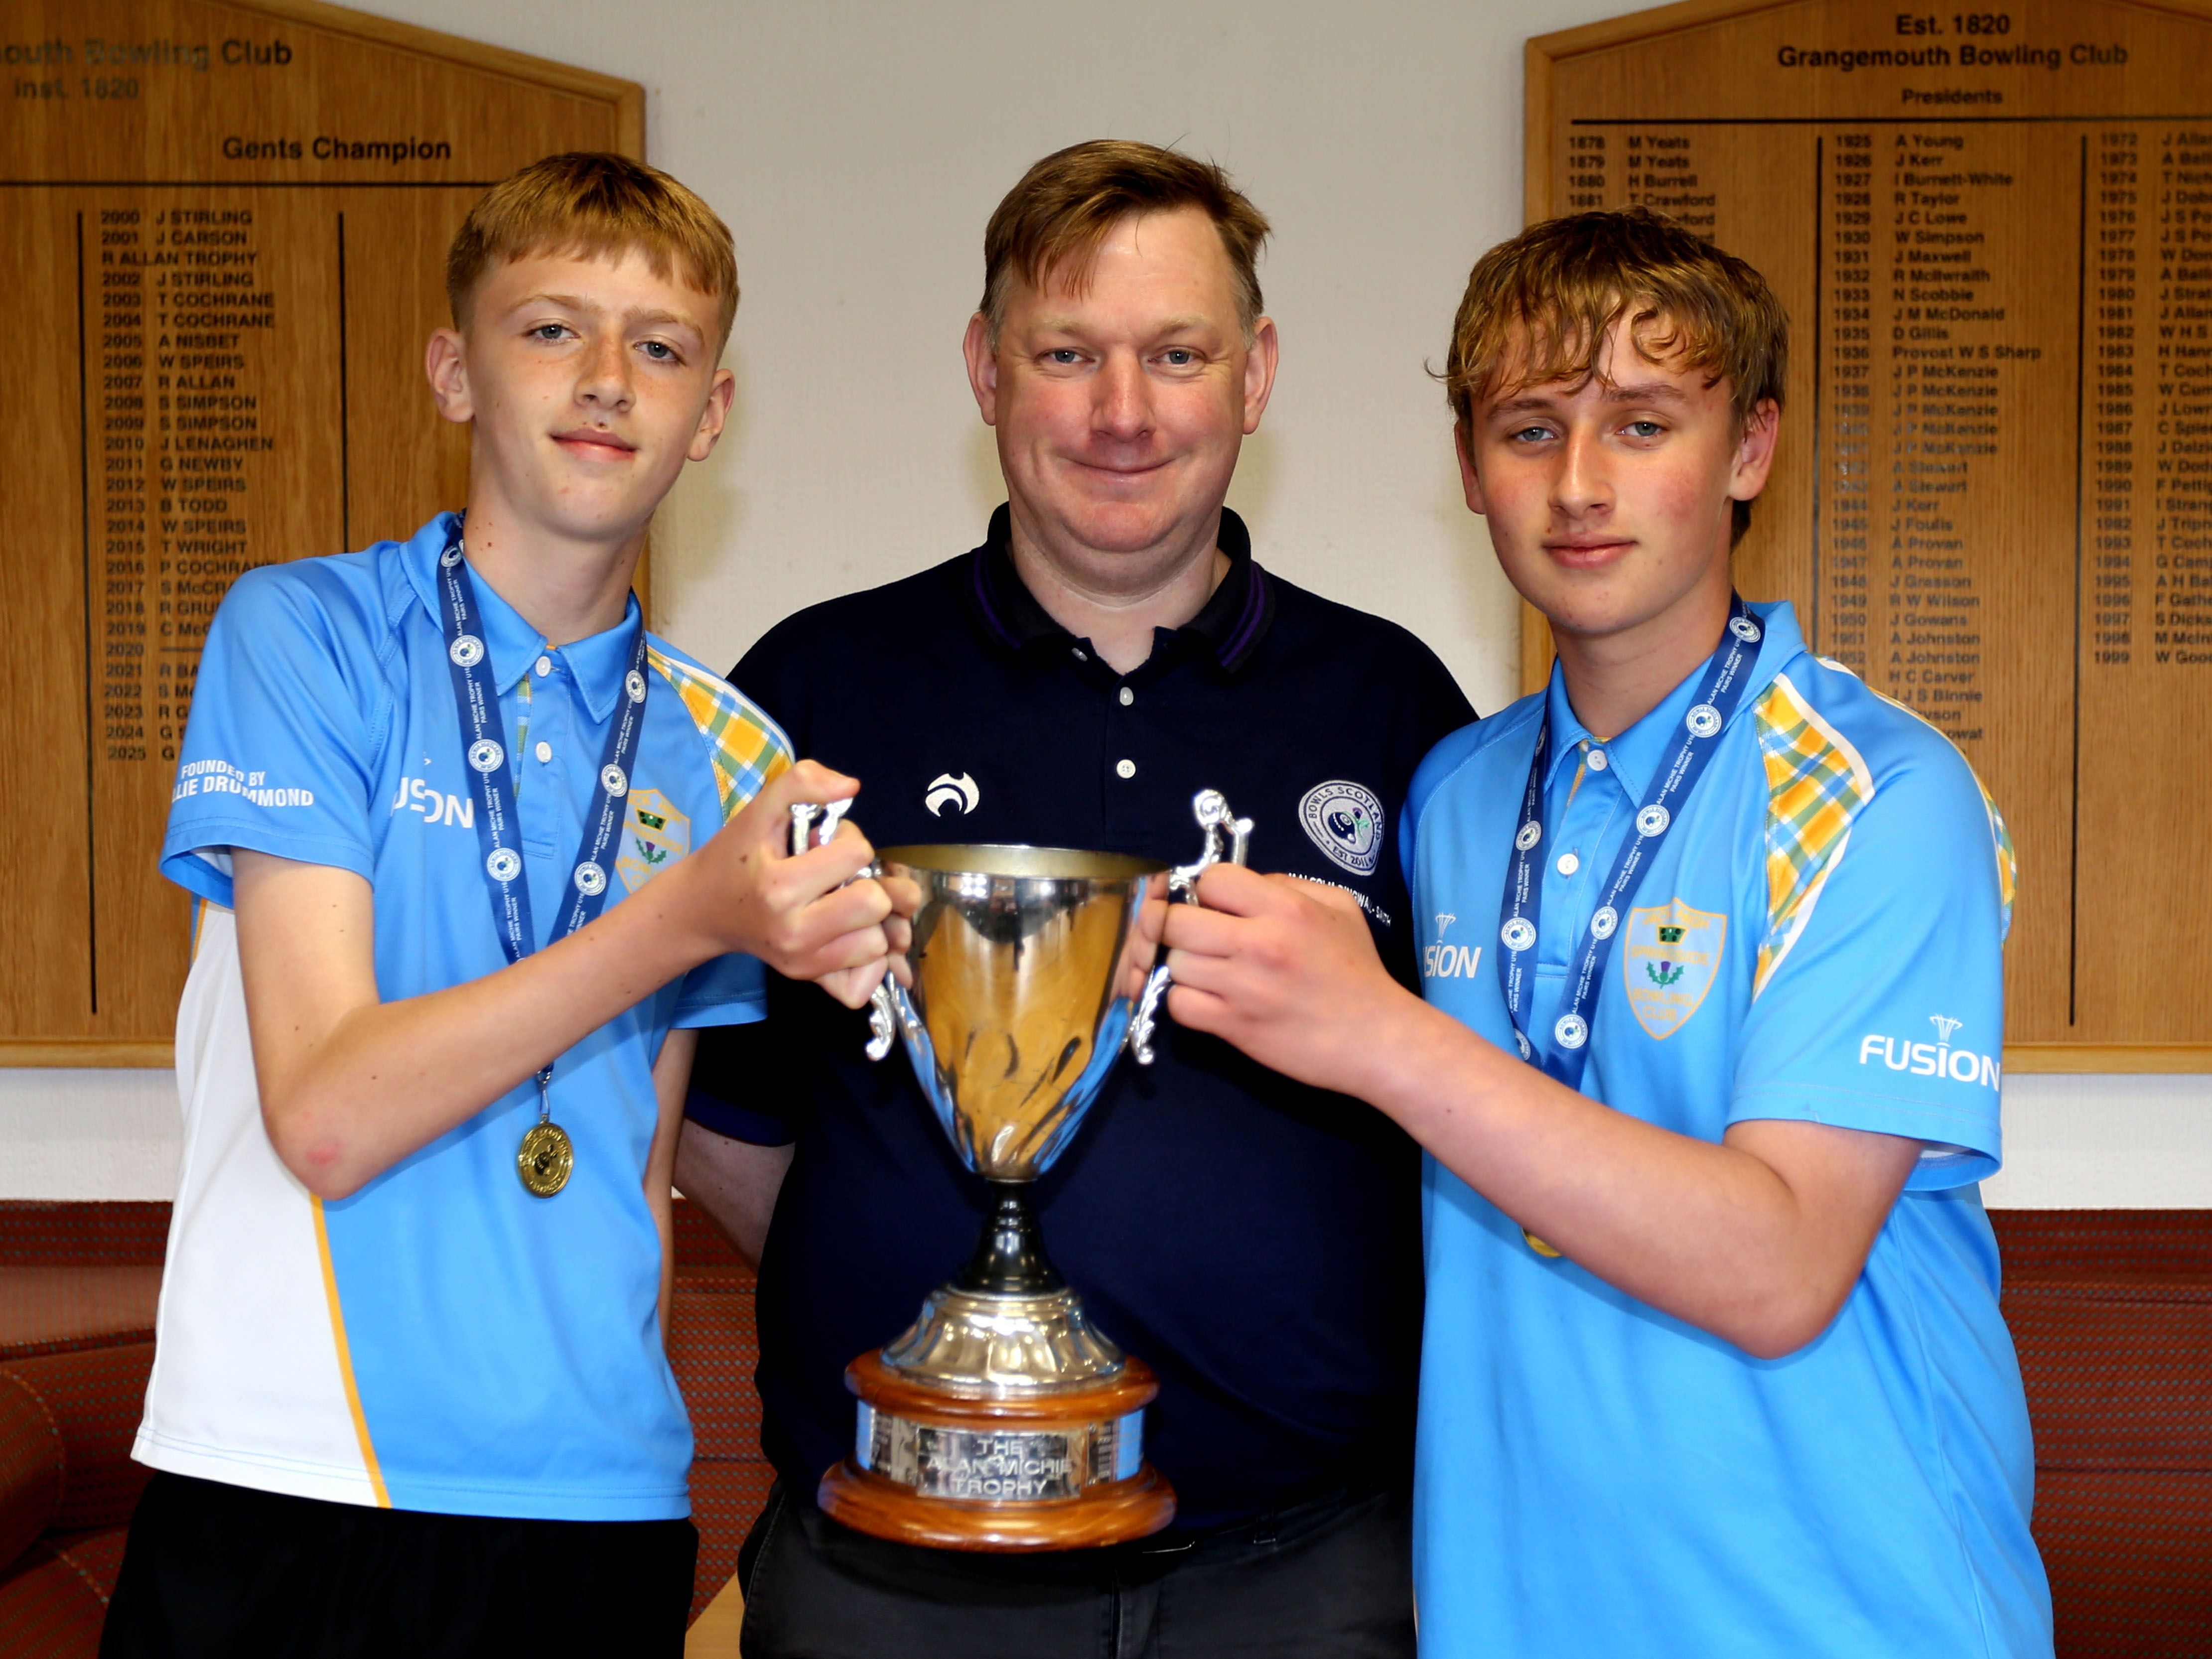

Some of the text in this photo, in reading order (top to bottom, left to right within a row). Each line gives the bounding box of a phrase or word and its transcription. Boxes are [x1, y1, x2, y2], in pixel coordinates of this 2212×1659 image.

[1897, 15, 2010, 35] Est. 1820
[4, 39, 292, 71] outh Bowling Club
[1778, 44, 2127, 71] Grangemouth Bowling Club
[1902, 89, 2003, 104] Presidents
[223, 136, 451, 165] Gents Champion
[1836, 154, 1942, 167] 1926 J Kerr
[1836, 192, 1960, 208] 1928 R Taylor
[102, 211, 252, 225] 2000 J STIRLING
[1836, 212, 1967, 224] 1929 J C Lowe
[102, 231, 247, 245] 2001 J CARSON
[1836, 231, 1984, 247] 1930 W Simpson
[103, 252, 256, 266] R ALLAN TROPHY
[1835, 251, 1971, 263] 1931 J Maxwell
[103, 272, 253, 286] 2002 J STIRLING
[1835, 270, 1870, 282] 1932
[1894, 270, 1904, 281] R
[103, 293, 274, 307] 2003 T COCHRANE
[1835, 289, 1870, 301] 1933
[1894, 289, 1905, 300] N
[104, 314, 275, 328] 2004 T COCHRANE
[1834, 308, 2004, 321] 1934 J M McDonald
[104, 334, 240, 348] 2005 A NISBET
[1834, 328, 1870, 340] 1935
[1894, 328, 1904, 340] D
[104, 355, 244, 368] 2006 W SPEIRS
[1834, 346, 2041, 362] 1936 Provost W S Sharp
[1834, 366, 1998, 379] 1937 J P McKenzie
[105, 376, 235, 389] 2007 R ALLAN
[105, 397, 143, 410] 2008
[177, 396, 256, 410] SIMPSON
[106, 417, 143, 430] 2009
[177, 417, 257, 430] SIMPSON
[106, 438, 273, 450] 2010 J LENAGHEN
[107, 458, 243, 471] 2011 G NEWBY
[107, 479, 246, 492] 2012 W SPEIRS
[107, 500, 144, 512] 2013
[179, 500, 227, 513] TODD
[108, 520, 246, 533] 2014 W SPEIRS
[107, 541, 247, 553] 2015 T WRIGHT
[107, 562, 144, 574] 2016
[161, 562, 170, 574] P
[181, 760, 266, 786] FOUNDED BY
[1657, 789, 1667, 805] ALAN
[1664, 768, 1677, 789] MICHIE
[1674, 744, 1689, 768] TROPHY
[1670, 751, 1694, 793] PAIRS WINNER
[203, 776, 314, 807] DRUMMOND
[485, 785, 493, 809] TROPHY
[492, 788, 505, 830] PAIRS WINNER
[1309, 787, 1382, 840] BOWLS SCOTLAND
[1333, 845, 1368, 866] EST 2011
[1607, 890, 1617, 906] ALAN
[1614, 870, 1627, 889] MICHIE
[1624, 846, 1638, 868] TROPHY
[1618, 851, 1642, 892] PAIRS WINNER
[1675, 909, 1710, 931] HIGH
[1423, 946, 1482, 978] SION
[1631, 945, 1711, 966] SPRINGSIDE
[1632, 988, 1693, 1006] BOWLING
[1643, 1005, 1677, 1021] CLUB
[1859, 1035, 2000, 1092] FUSION
[976, 1439, 1023, 1455] THE
[927, 1457, 1072, 1476] ALAN MICHIE
[952, 1478, 1047, 1495] TROPHY
